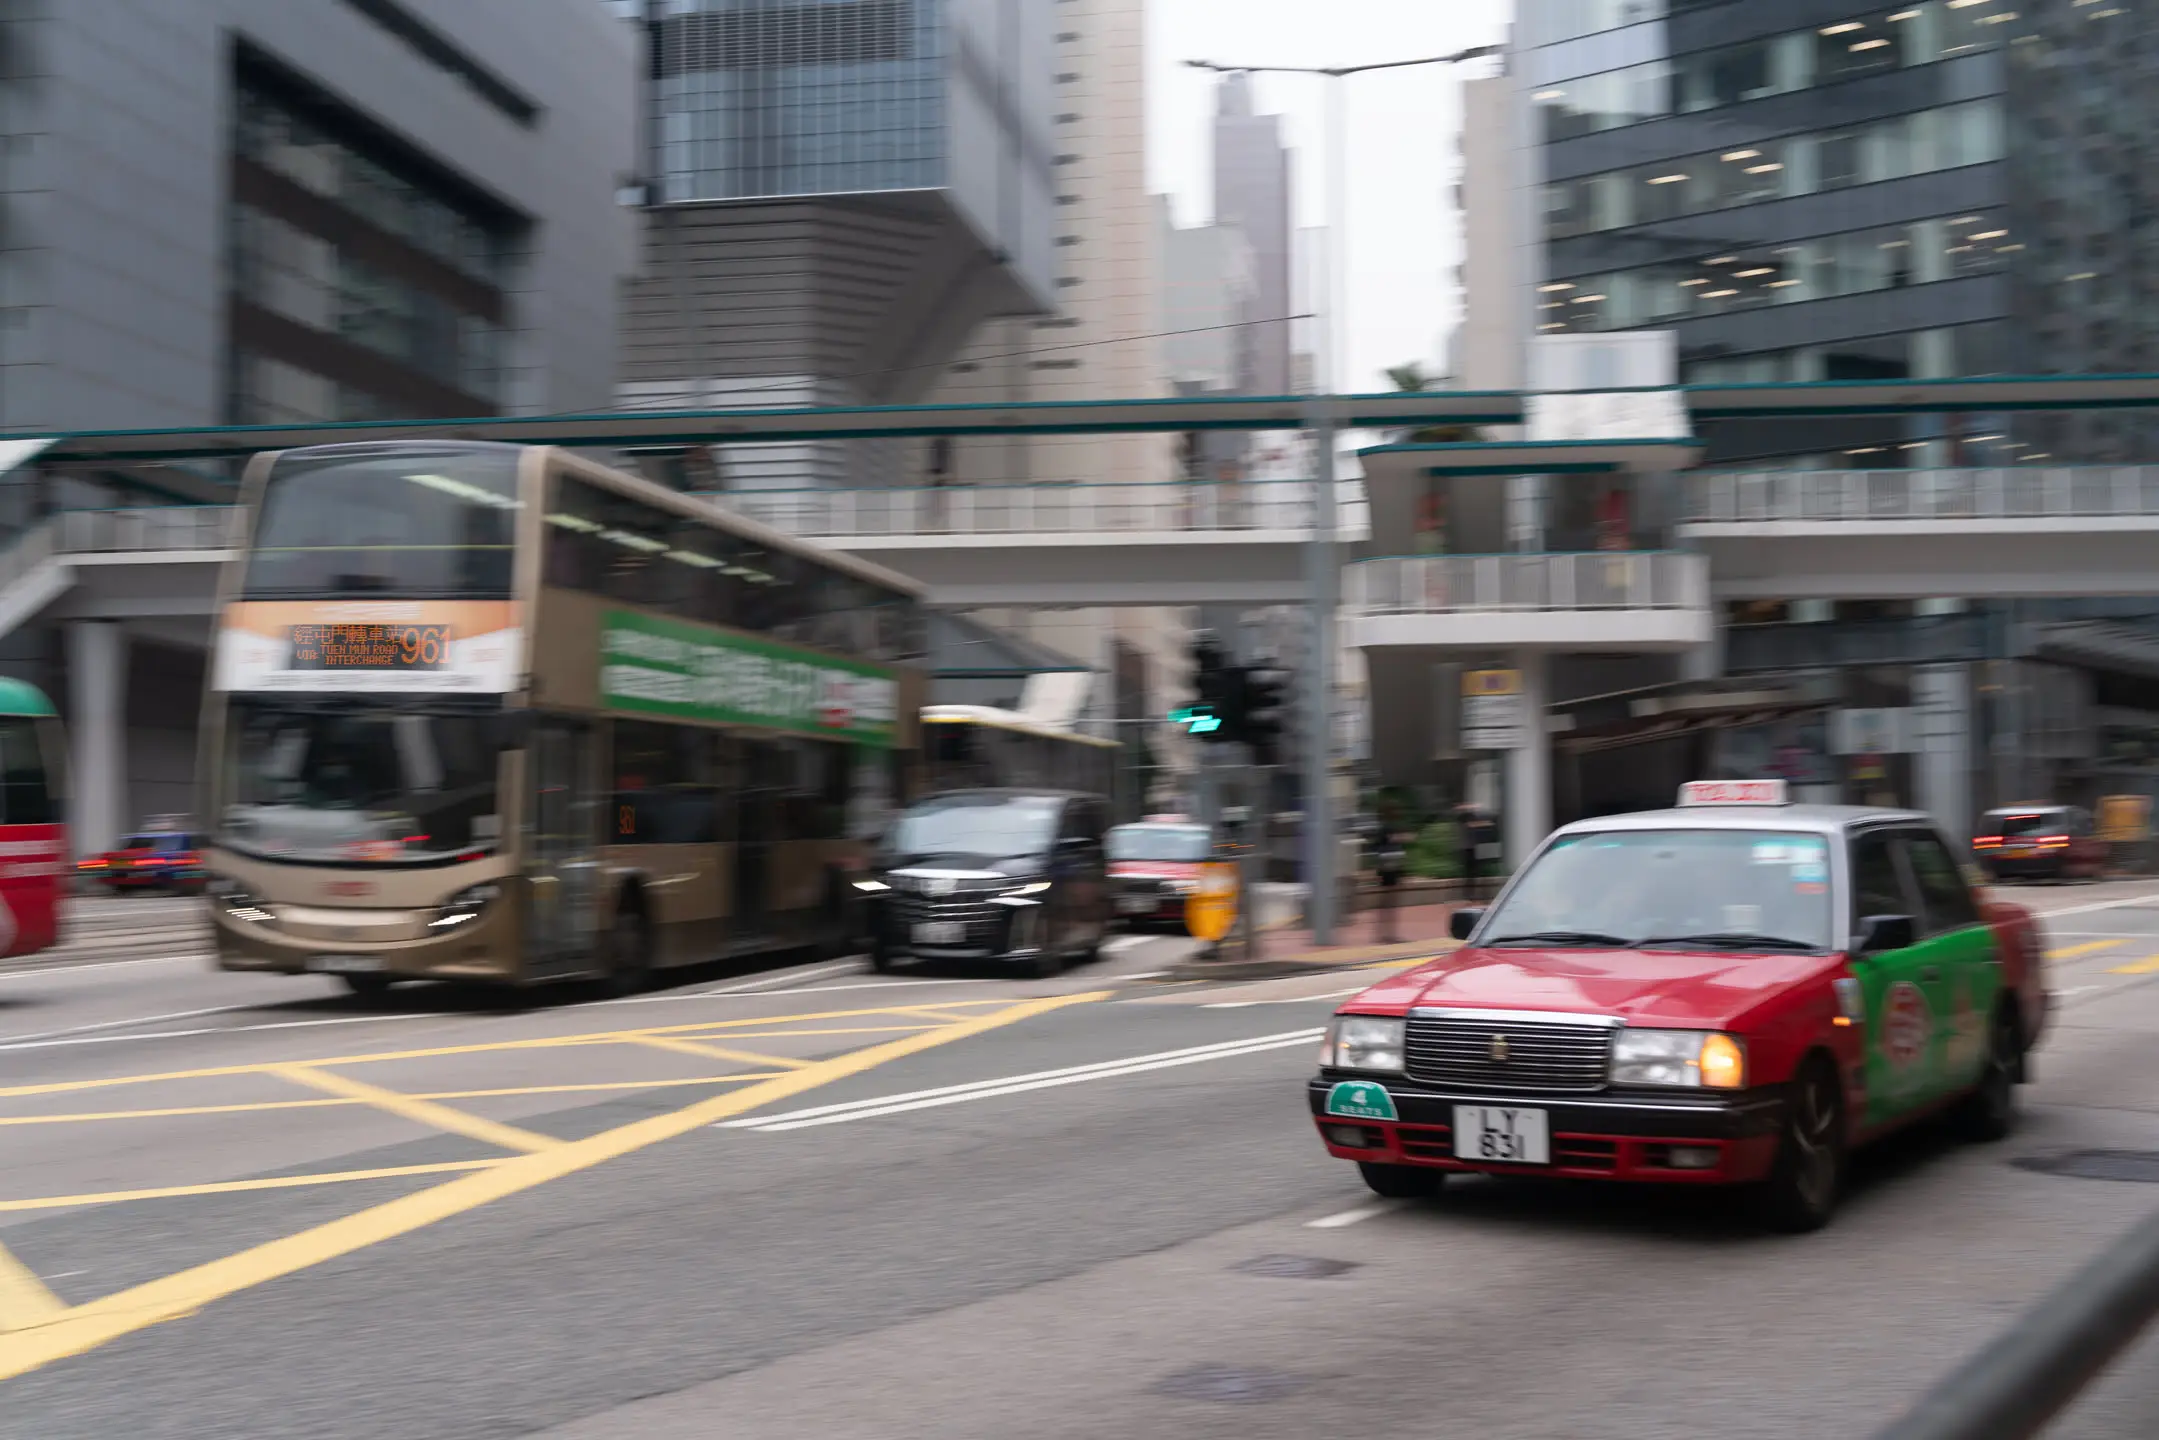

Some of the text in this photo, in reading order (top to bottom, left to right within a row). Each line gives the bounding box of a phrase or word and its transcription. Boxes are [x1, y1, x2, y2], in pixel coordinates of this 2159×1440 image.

[320, 644, 399, 655] TUEN MUN ROAD
[401, 627, 452, 664] 961
[325, 654, 394, 665] INTERCHANGE
[1350, 1089, 1368, 1106] 4
[1480, 1108, 1519, 1134] LY
[1478, 1133, 1525, 1159] 831
